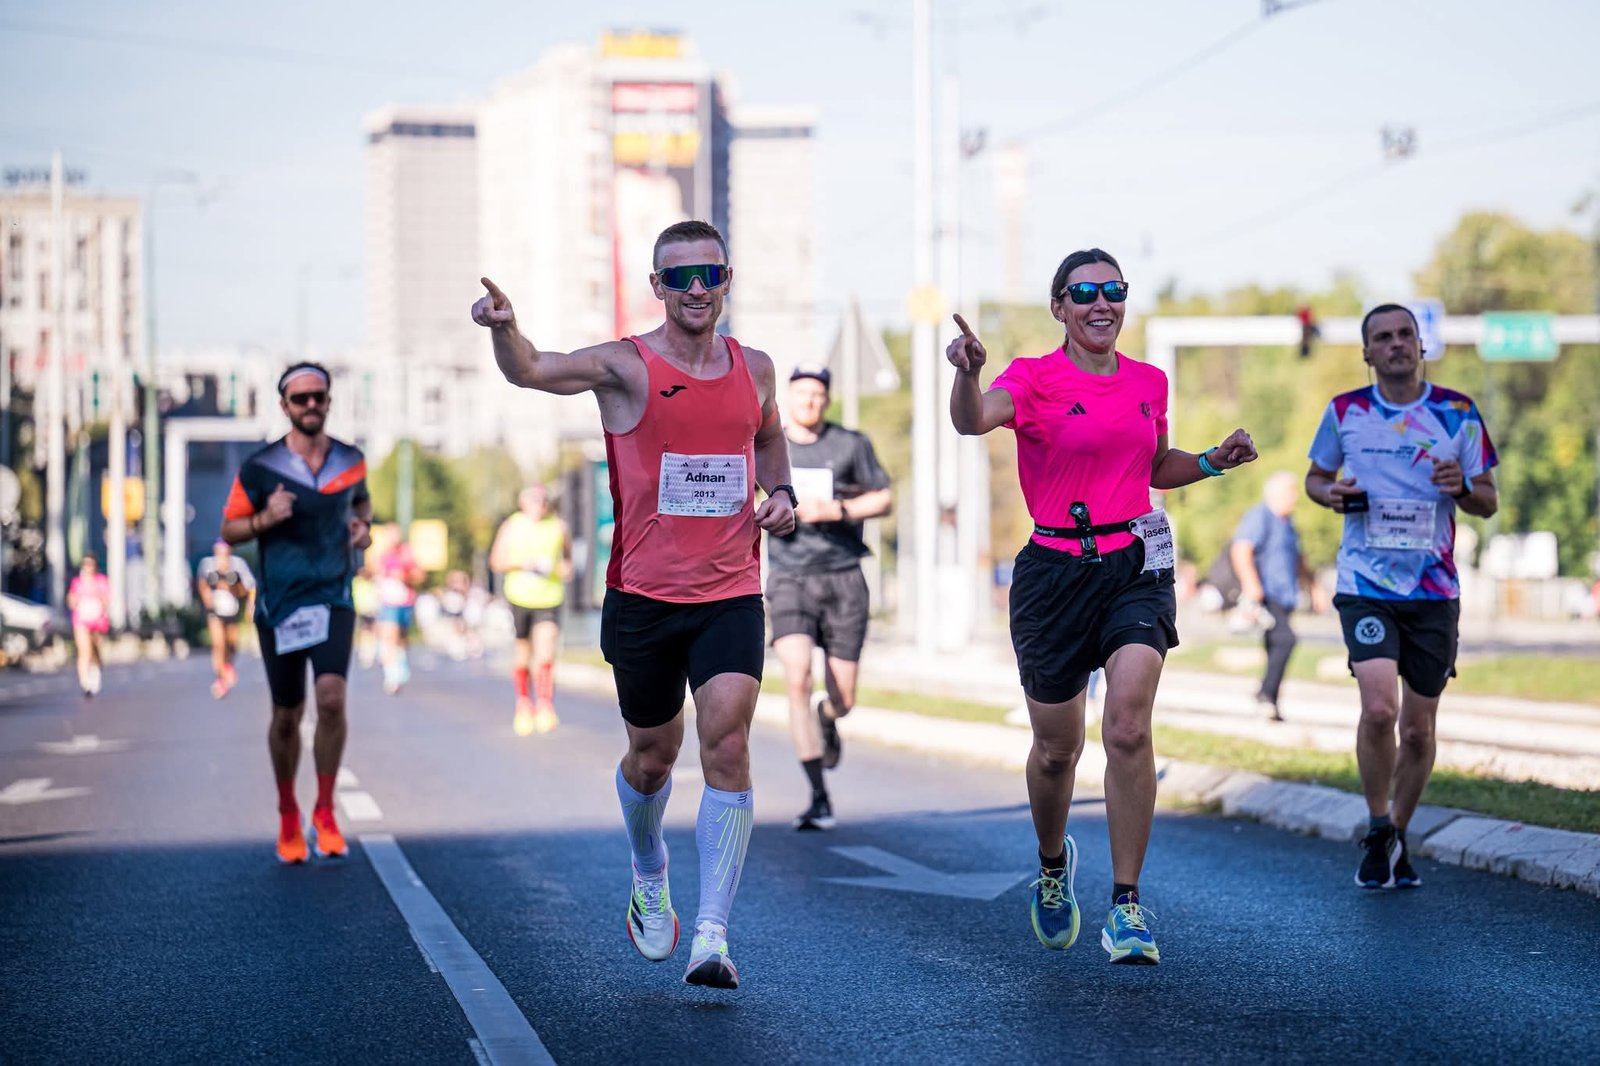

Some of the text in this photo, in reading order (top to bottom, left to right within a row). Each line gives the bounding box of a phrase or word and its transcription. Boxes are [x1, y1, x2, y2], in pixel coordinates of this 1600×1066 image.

[685, 472, 726, 483] Adnan
[694, 490, 716, 498] 2013
[1156, 541, 1173, 551] 2463
